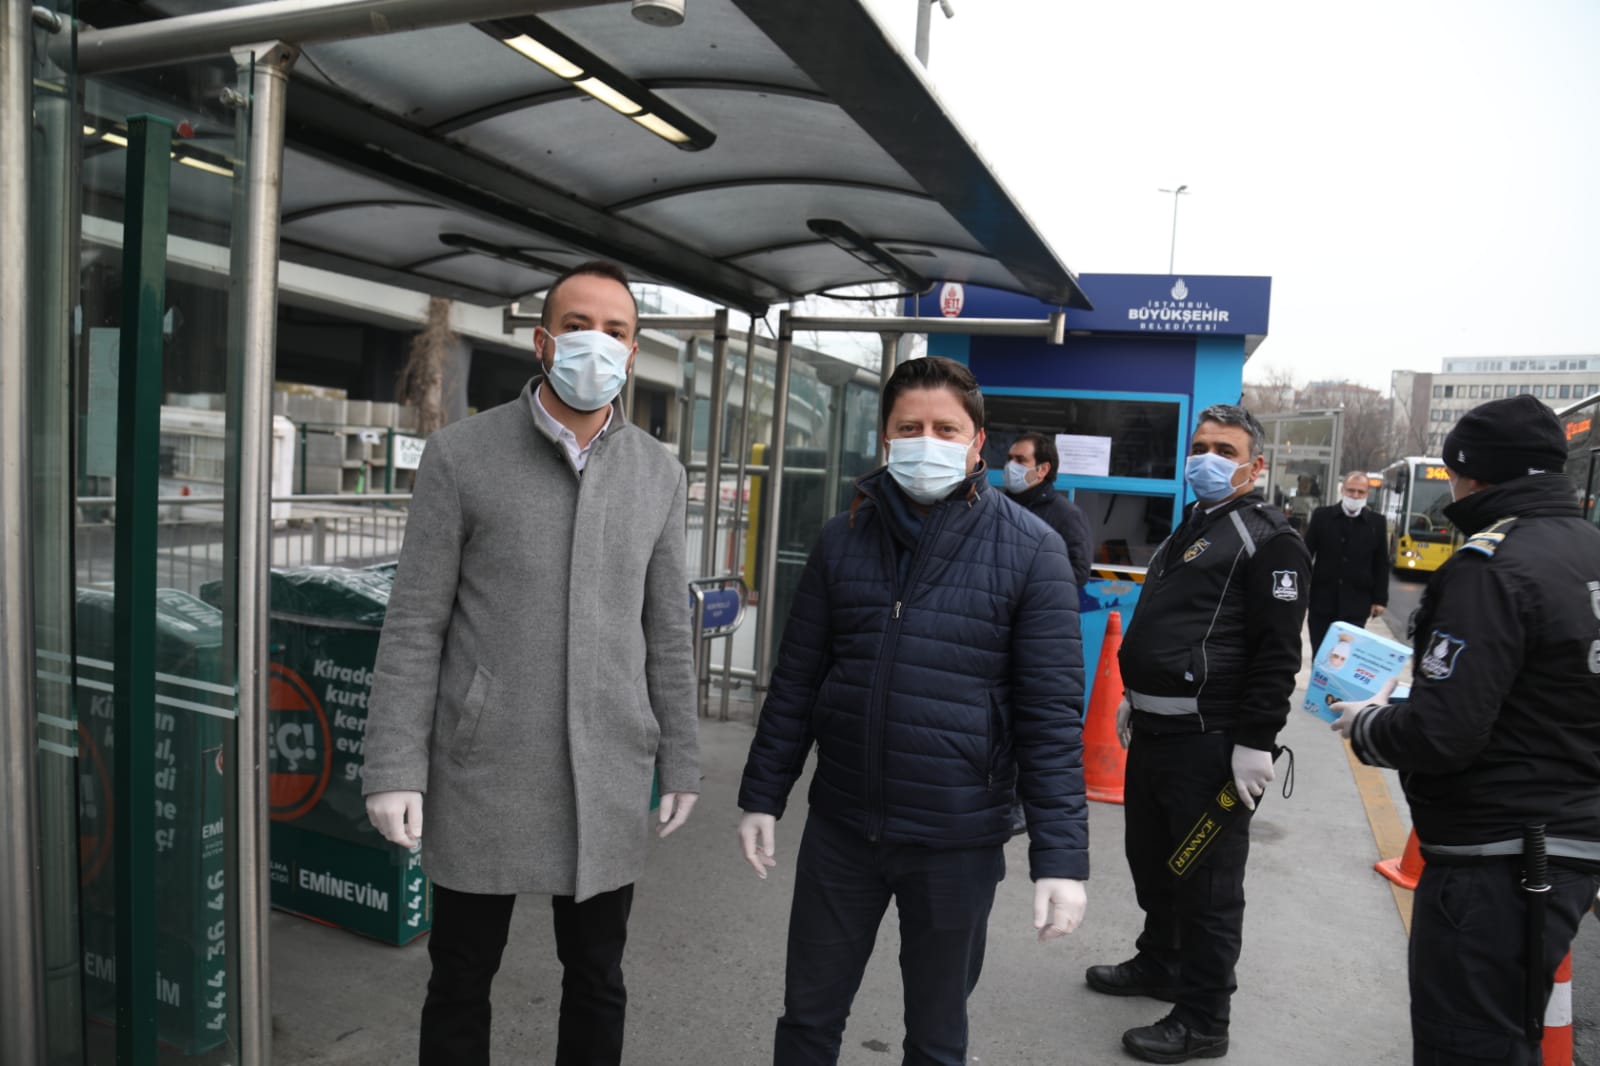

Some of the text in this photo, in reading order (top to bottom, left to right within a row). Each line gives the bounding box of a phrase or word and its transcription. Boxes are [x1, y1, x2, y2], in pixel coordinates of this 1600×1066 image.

[1127, 306, 1230, 323] BÜYÜKŞEHİR
[1148, 300, 1210, 309] İSTANBUL
[1140, 322, 1216, 331] BELEDİYESİ
[313, 659, 375, 686] Kirada
[325, 684, 369, 709] kurt
[269, 722, 318, 772] Ç!
[299, 868, 390, 913] EMİNEVİM
[408, 877, 423, 928] 444
[207, 919, 225, 961] 36
[206, 968, 227, 1031] 444
